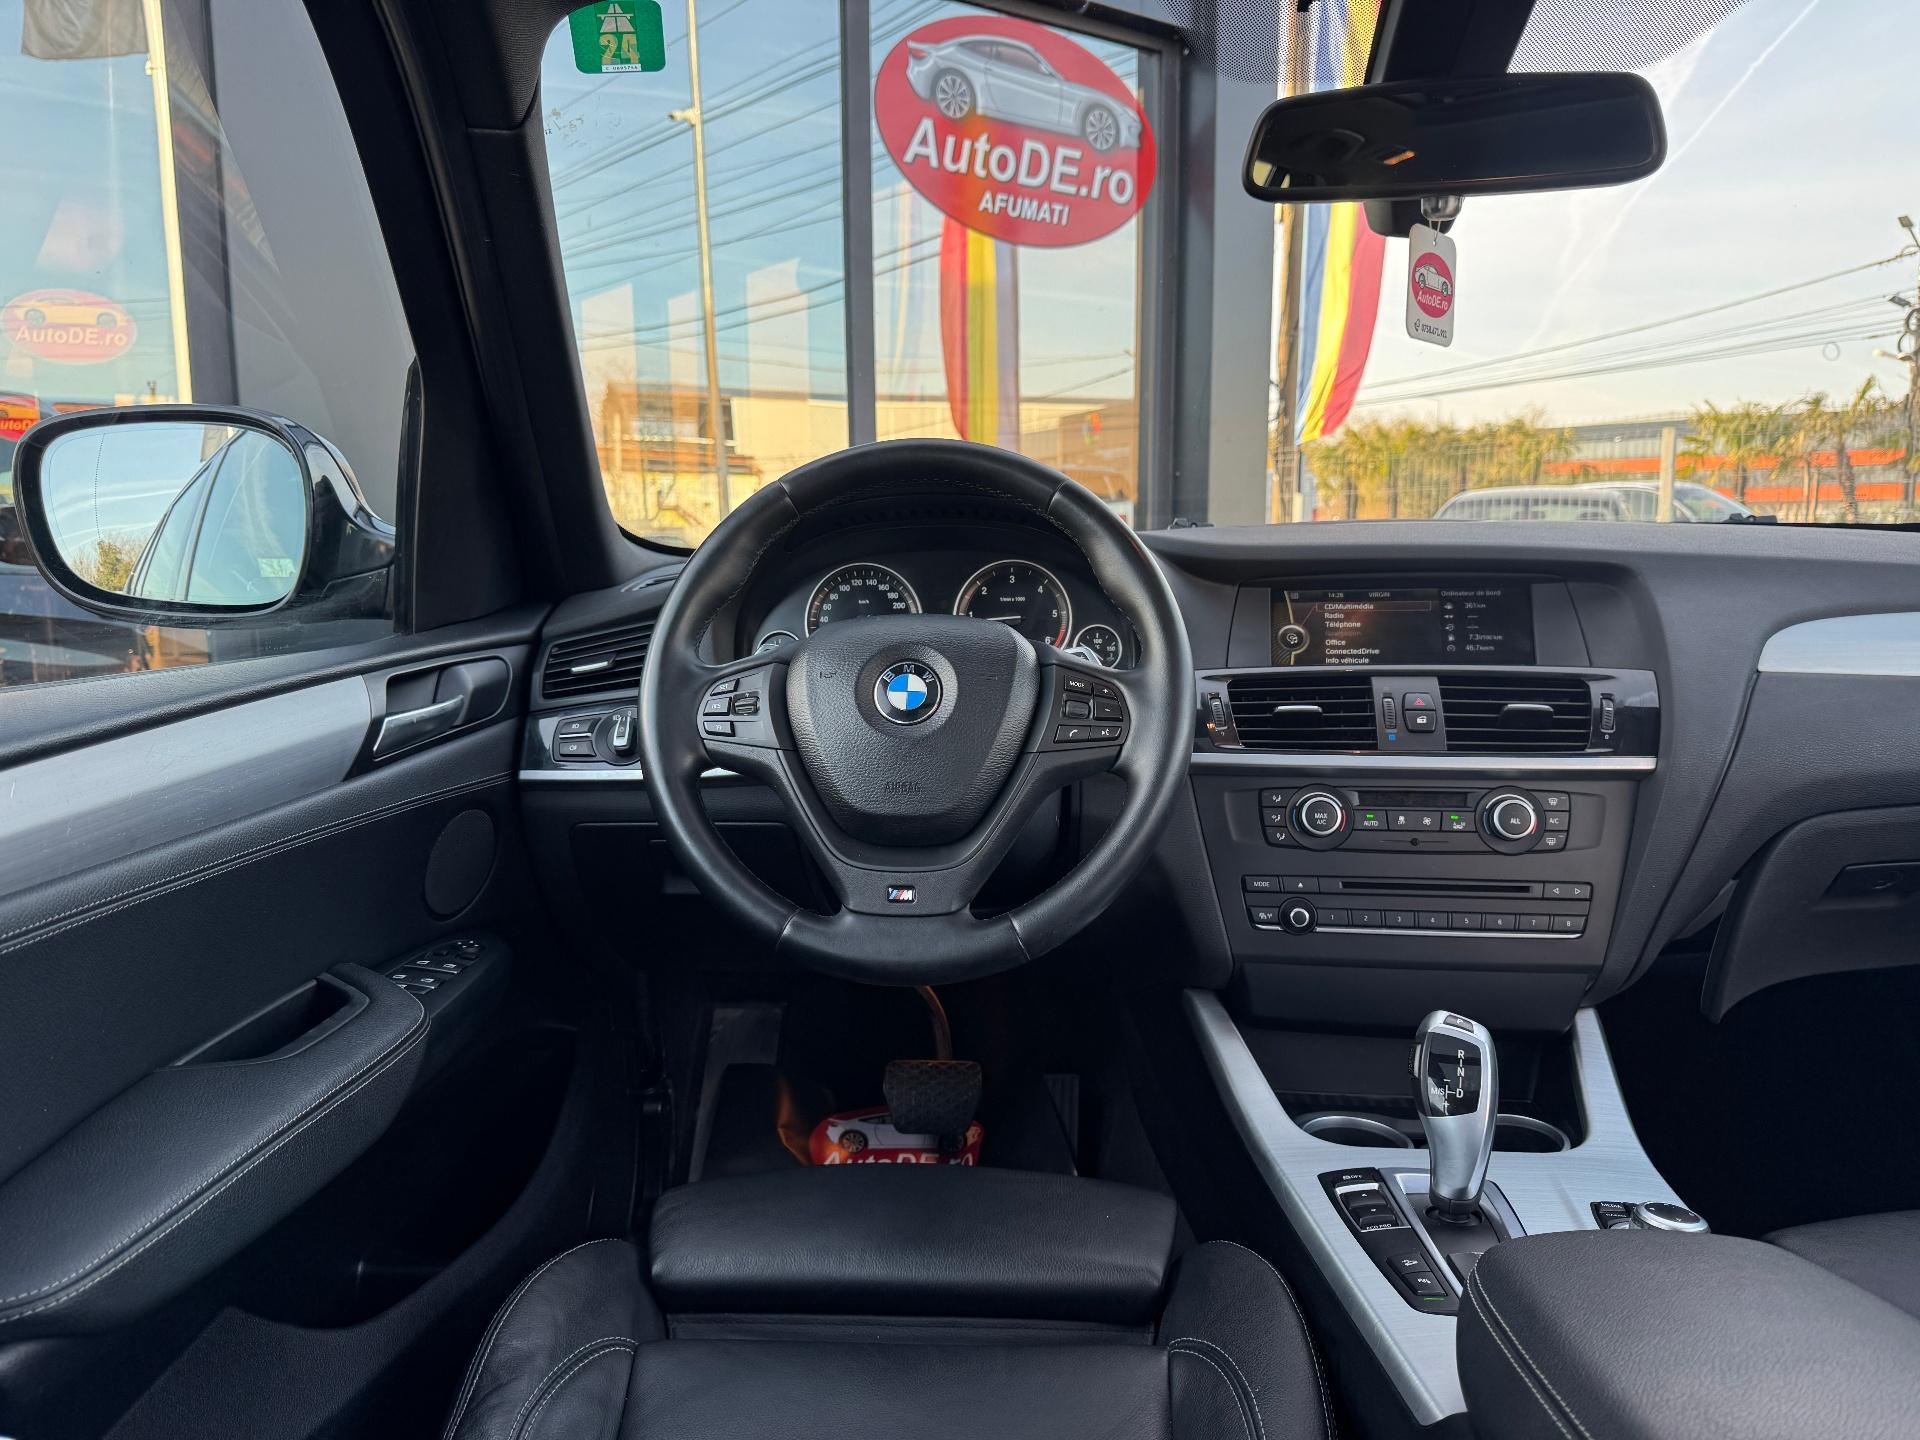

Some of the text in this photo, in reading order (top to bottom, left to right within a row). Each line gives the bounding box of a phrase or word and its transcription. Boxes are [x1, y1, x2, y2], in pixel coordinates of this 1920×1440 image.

[903, 116, 1134, 205] AutoDE.ro
[978, 192, 1070, 226] AFUMATI
[1417, 291, 1448, 310] AutoDE.ro
[15, 325, 128, 346] AutoDE.ro
[1009, 575, 1015, 584] 3
[981, 587, 988, 595] 2
[1038, 586, 1044, 594] 4
[1052, 610, 1058, 618] 5
[882, 664, 935, 684] BMW
[1458, 1049, 1465, 1060] R
[1458, 1067, 1465, 1077] N
[1430, 1088, 1445, 1096] M/S
[1456, 1088, 1464, 1098] D
